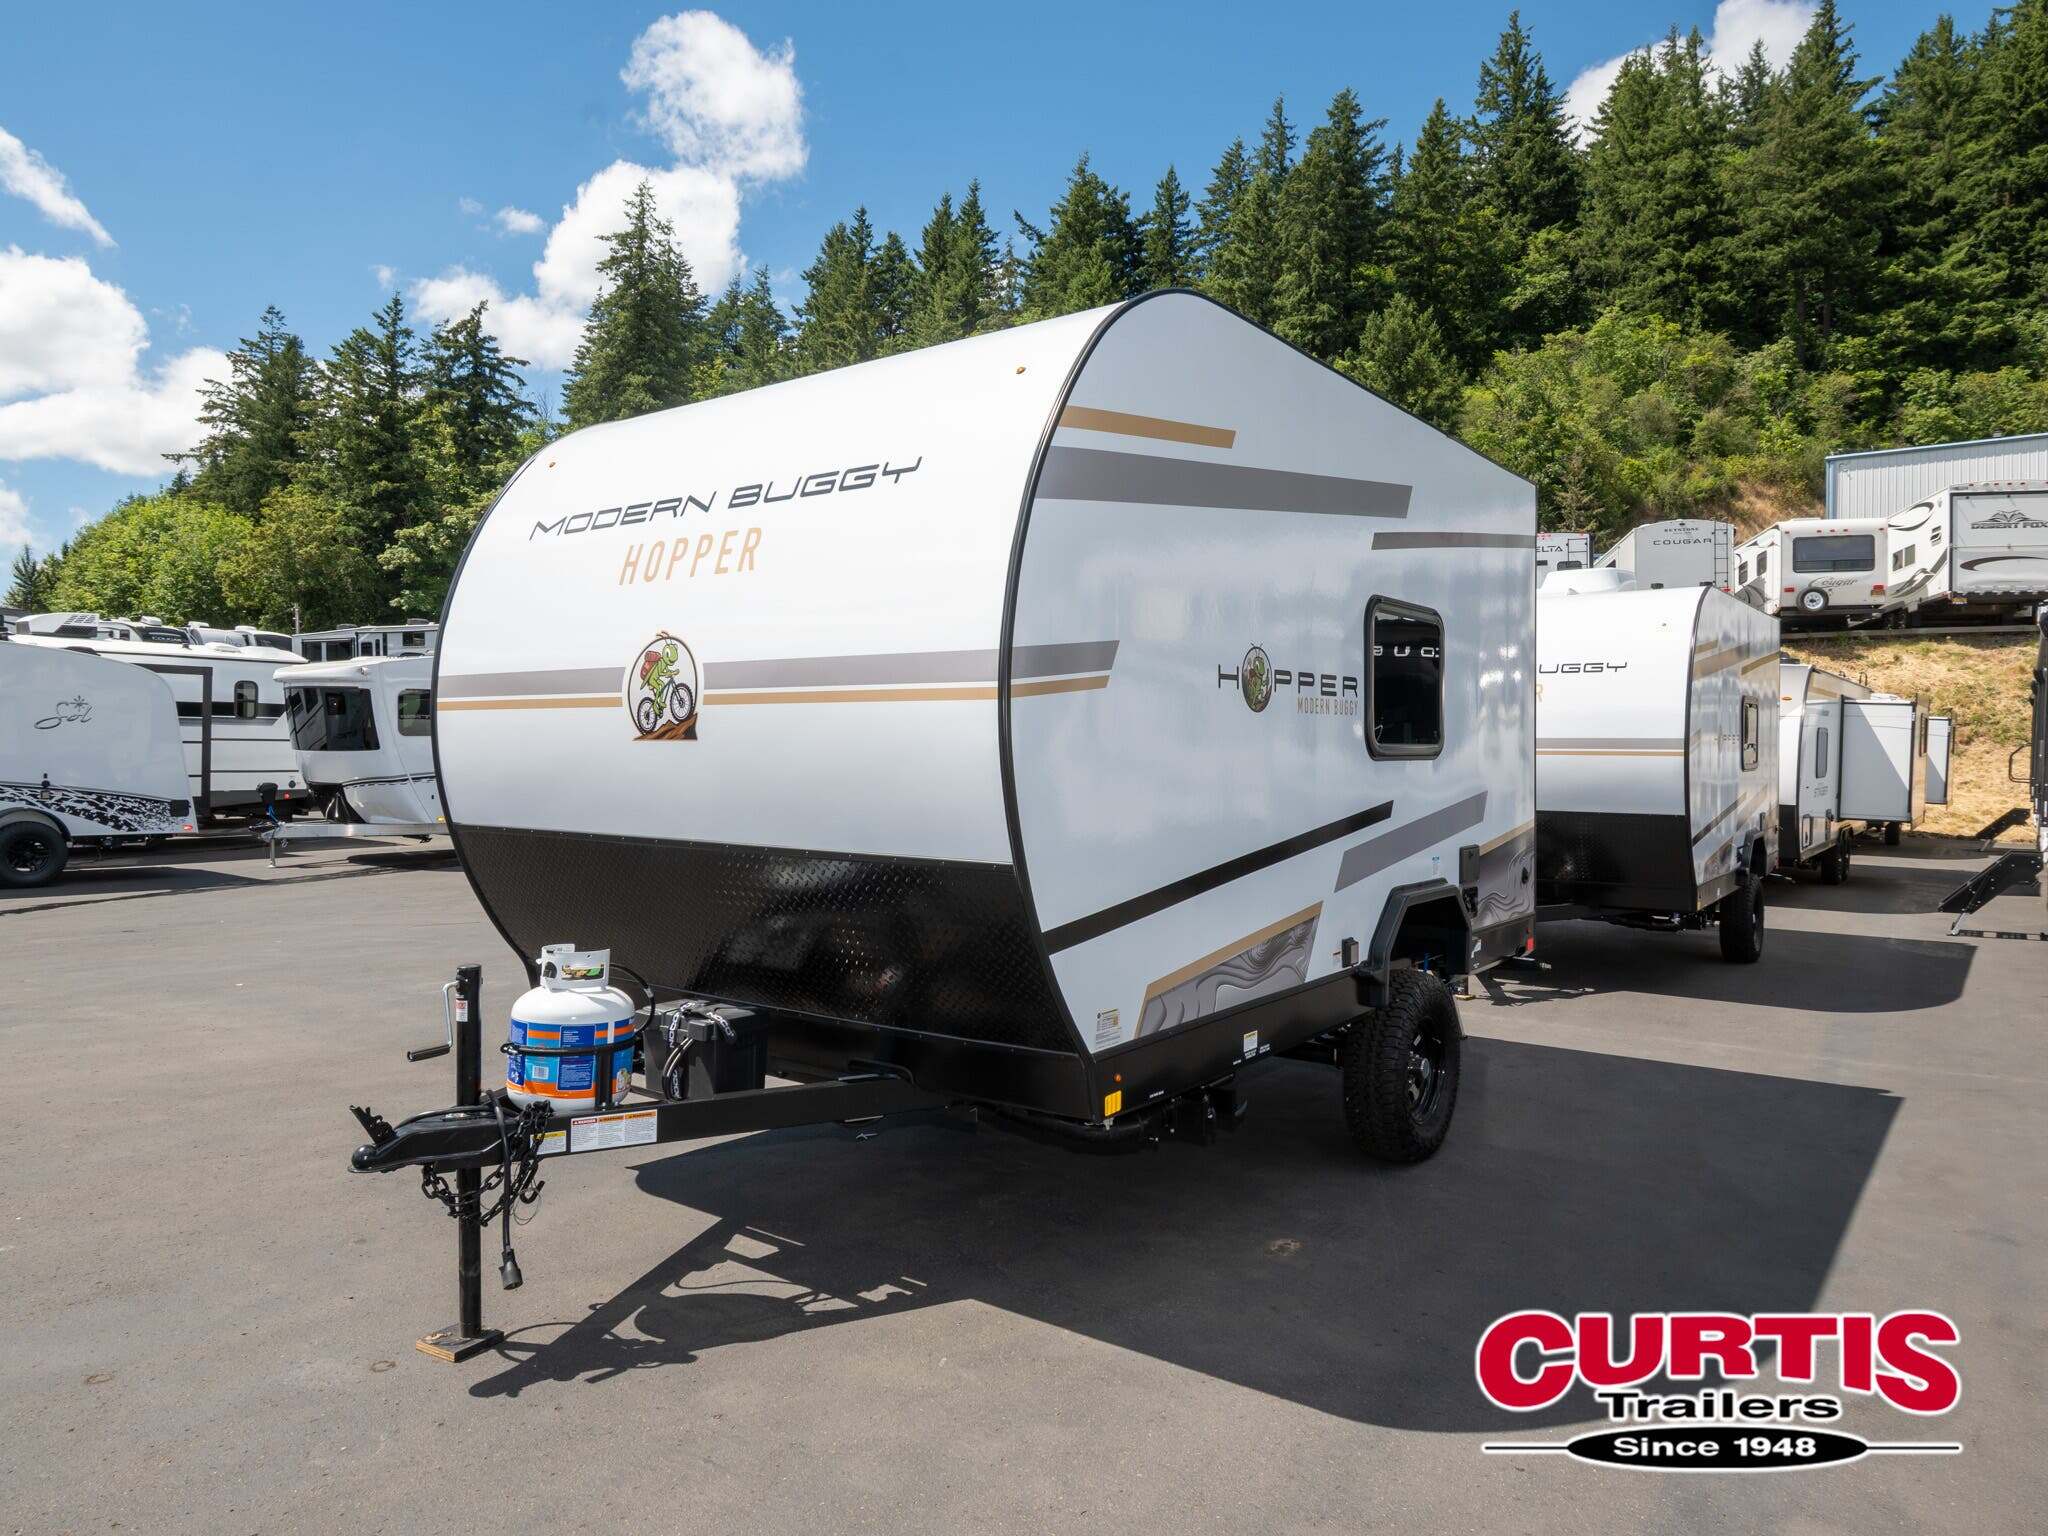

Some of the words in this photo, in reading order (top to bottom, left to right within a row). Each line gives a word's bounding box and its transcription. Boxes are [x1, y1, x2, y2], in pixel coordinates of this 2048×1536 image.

[529, 491, 717, 541] MODERN
[728, 456, 922, 509] BUGGY
[1971, 522, 2018, 530] DESERT
[2022, 521, 2048, 529] FOX
[1653, 538, 1712, 546] COUGAR
[618, 527, 762, 585] HOPPER
[1297, 697, 1330, 715] MODERN
[1334, 700, 1359, 716] BUGGY
